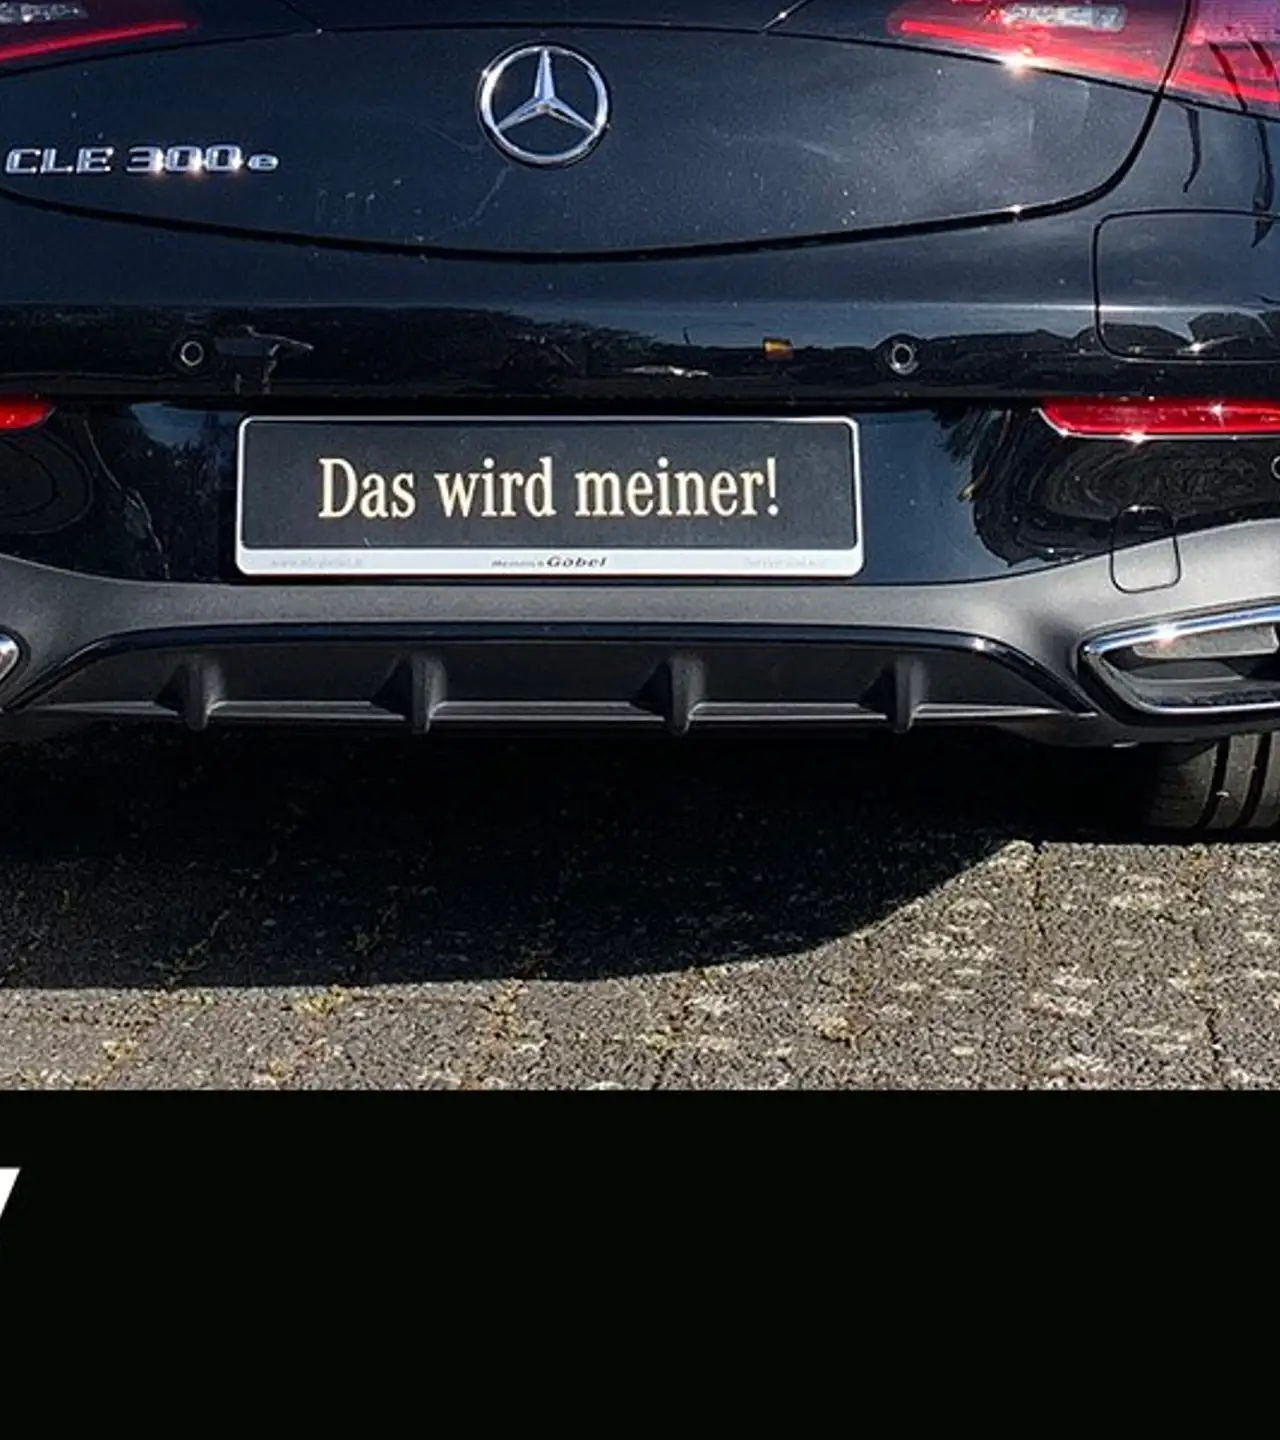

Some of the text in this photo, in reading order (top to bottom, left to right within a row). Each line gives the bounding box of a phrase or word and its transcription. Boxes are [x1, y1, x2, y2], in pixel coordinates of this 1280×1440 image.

[5, 146, 114, 174] CLE
[317, 456, 780, 519] Das wird meiner!
